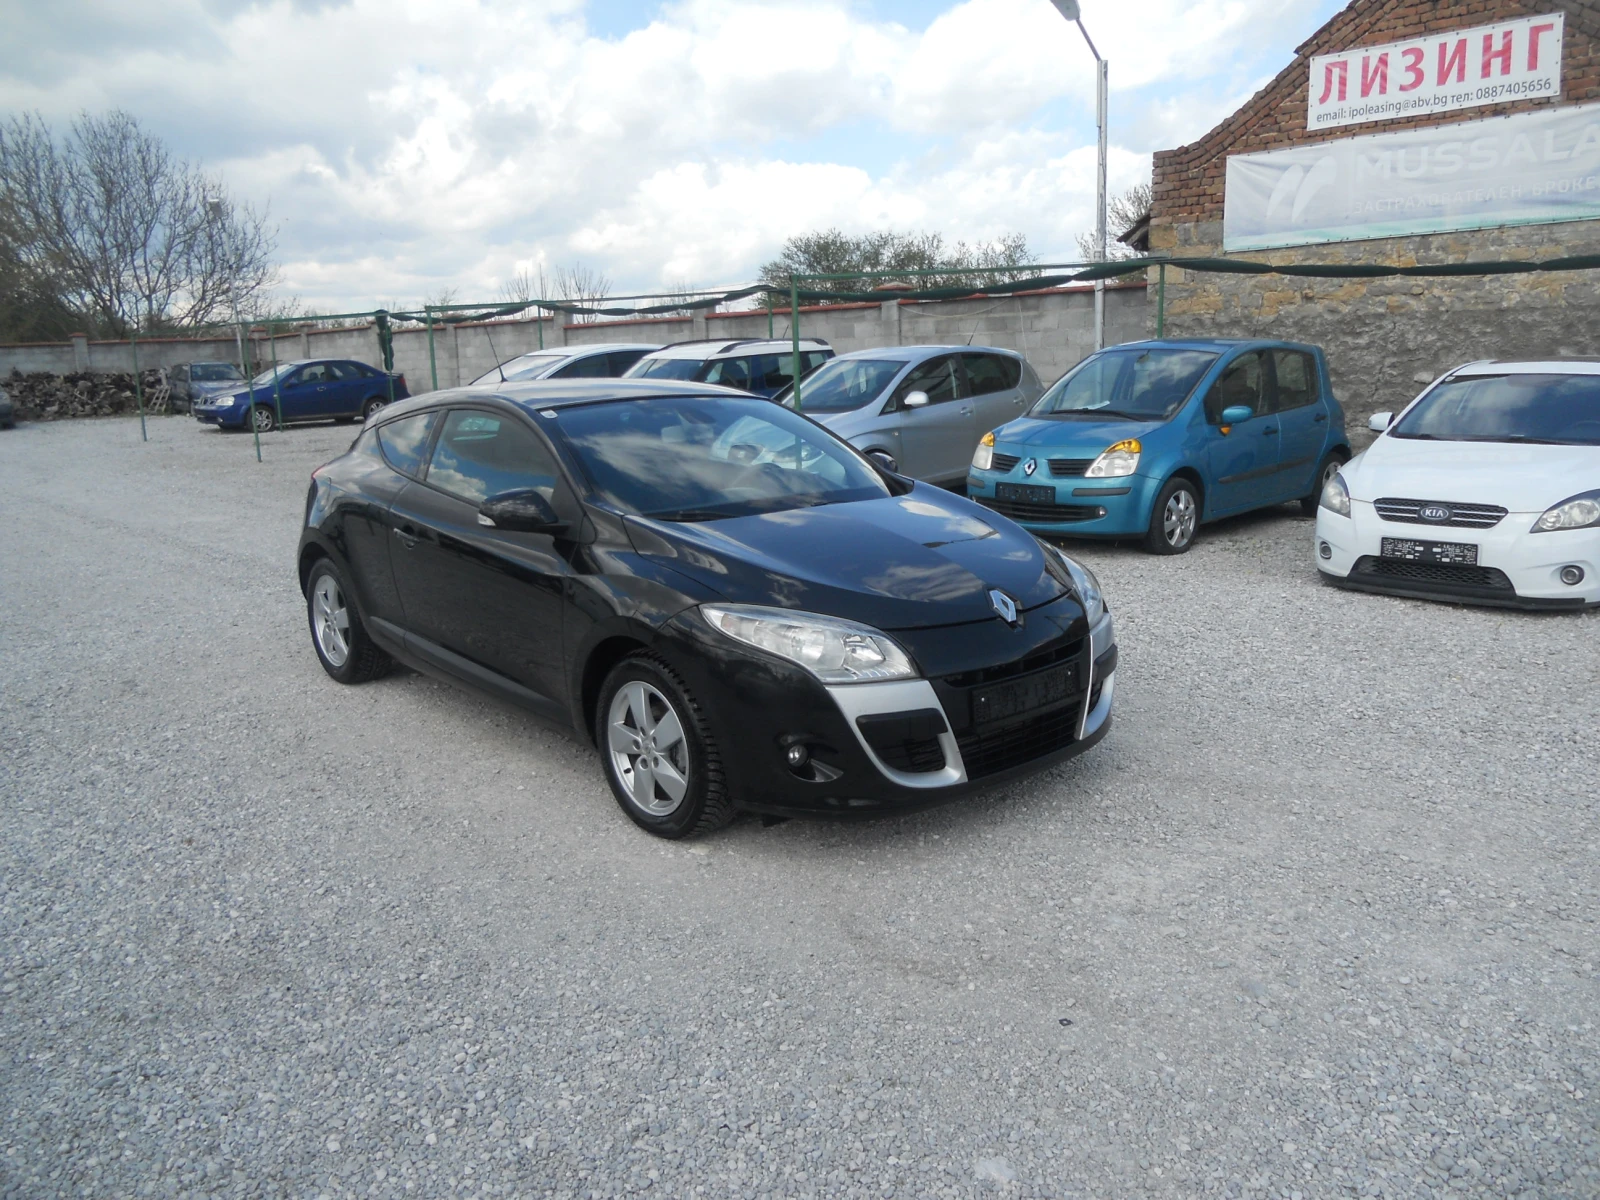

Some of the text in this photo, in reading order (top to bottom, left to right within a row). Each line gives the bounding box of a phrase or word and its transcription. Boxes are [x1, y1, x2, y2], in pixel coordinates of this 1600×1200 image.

[1319, 23, 1554, 105] ЛИЗИНГ
[1316, 78, 1551, 123] email: ipoleasing@abv.bg тел: 0887405656
[1356, 124, 1600, 183] MUSSALA
[1425, 509, 1444, 517] KIA
